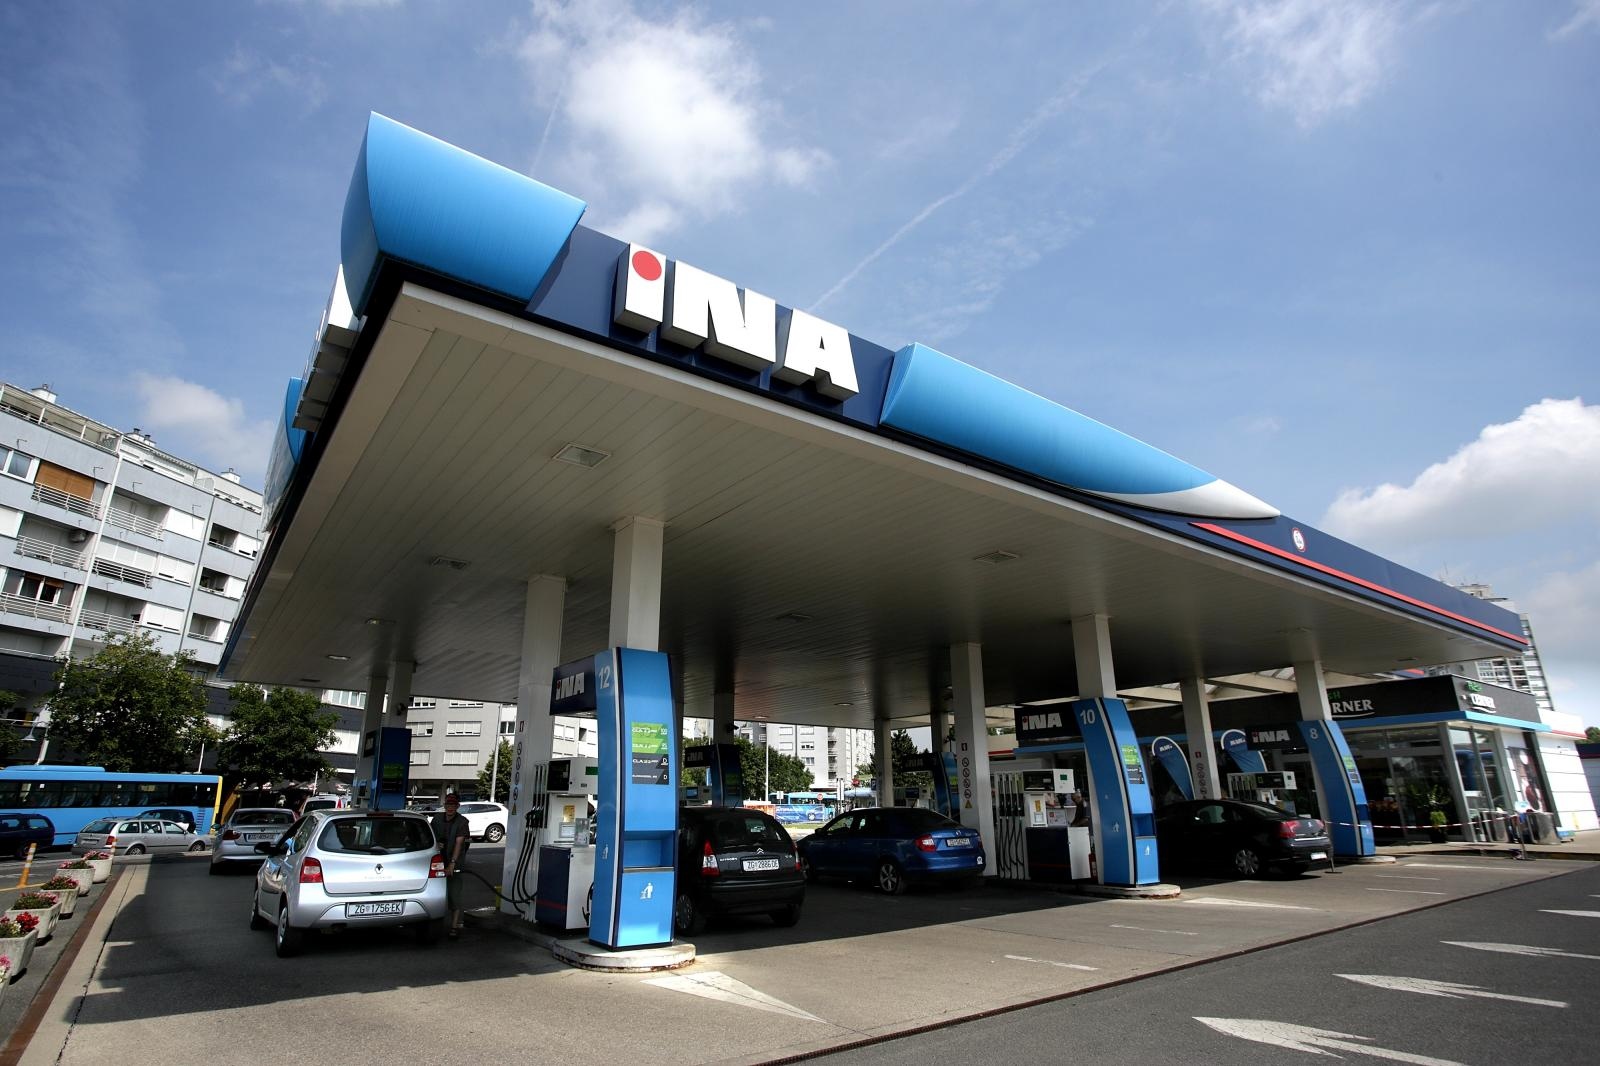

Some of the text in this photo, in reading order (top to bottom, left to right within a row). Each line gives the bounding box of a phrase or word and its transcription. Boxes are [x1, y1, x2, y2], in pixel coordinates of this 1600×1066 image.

[599, 665, 611, 689] 12
[1331, 699, 1374, 713] RNER
[1080, 709, 1096, 725] 10
[1309, 728, 1318, 739] 8
[355, 904, 365, 914] ZG
